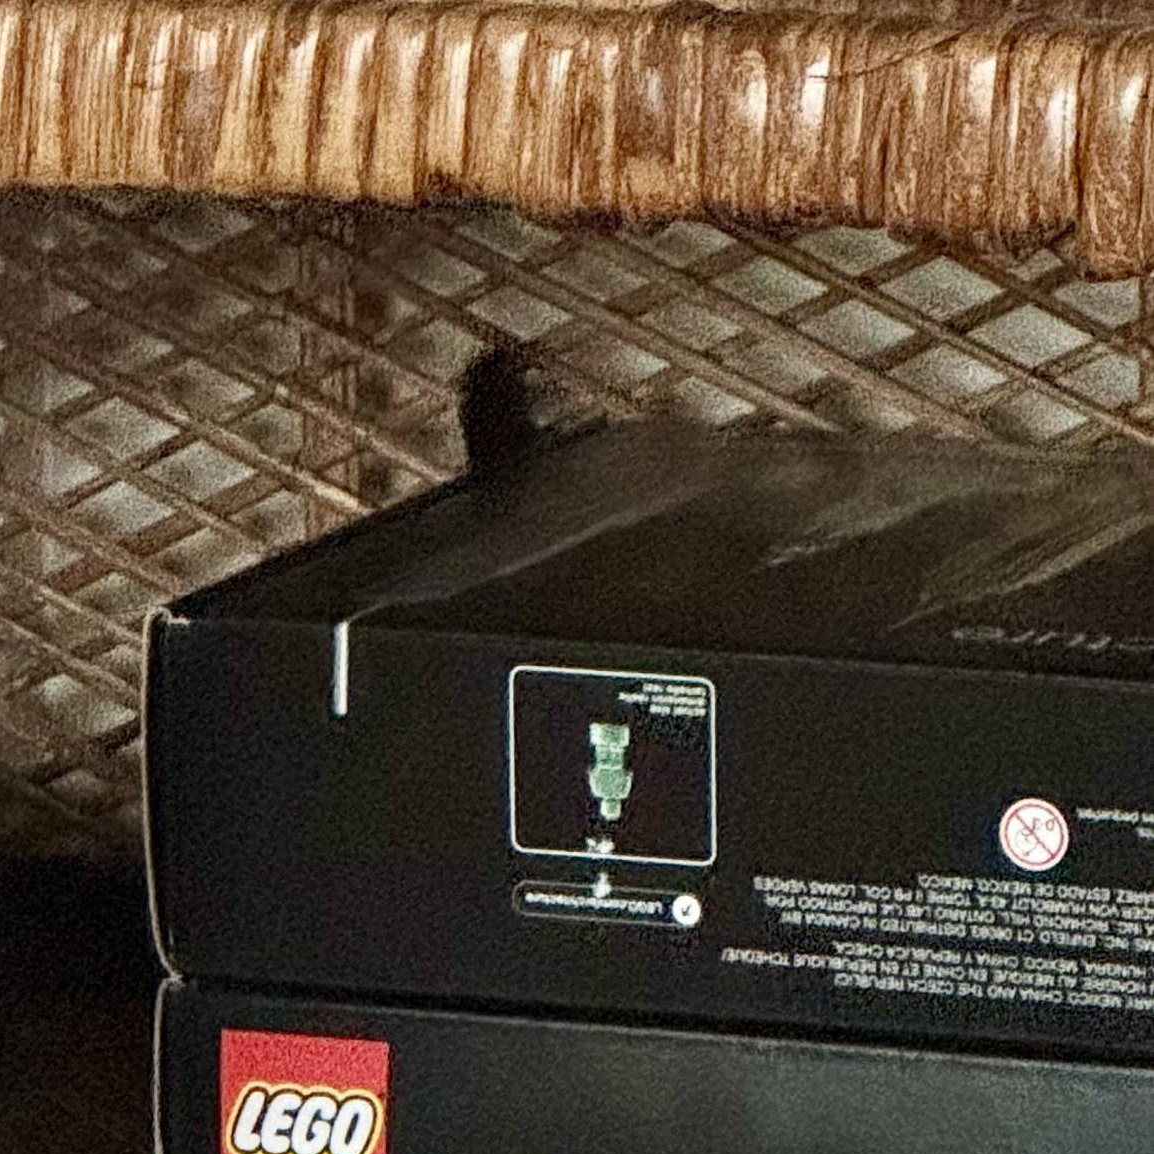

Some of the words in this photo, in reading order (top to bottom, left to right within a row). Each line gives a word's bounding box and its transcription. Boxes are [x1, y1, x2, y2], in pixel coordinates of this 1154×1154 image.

[1012, 897, 1085, 913] HUMBOLDT
[1089, 903, 1117, 916] VON
[987, 985, 1015, 999] AND
